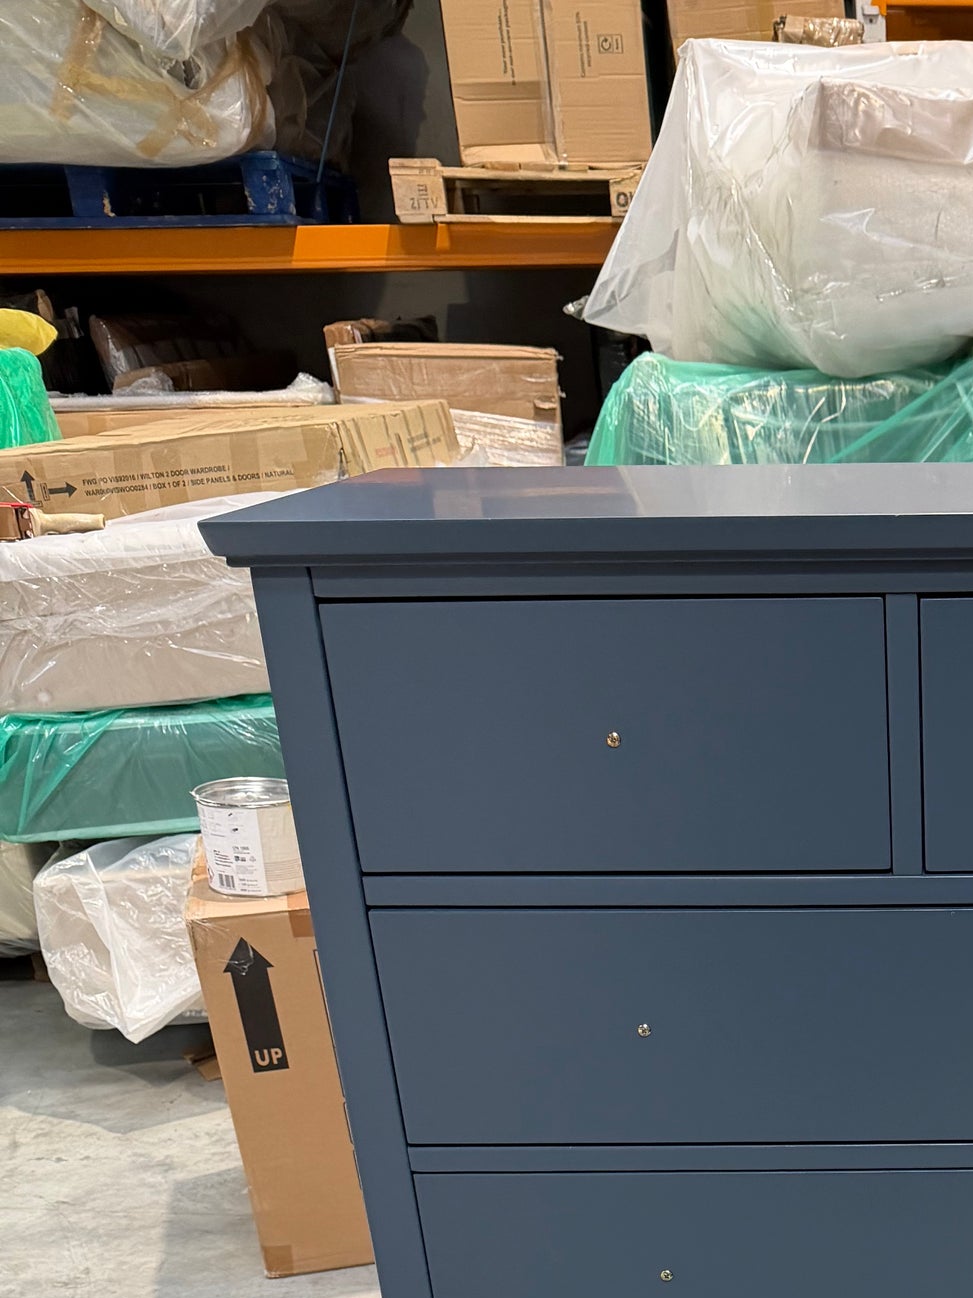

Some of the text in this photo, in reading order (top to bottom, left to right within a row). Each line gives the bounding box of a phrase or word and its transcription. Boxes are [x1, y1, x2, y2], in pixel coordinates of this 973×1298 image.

[153, 481, 167, 490] BOX
[191, 477, 205, 487] SIDE
[206, 474, 231, 485] PANELS
[238, 472, 260, 481] DOORS
[264, 469, 294, 479] NATURAL
[170, 468, 190, 477] DOOR
[190, 464, 226, 475] WARDROBE
[254, 1047, 283, 1067] UP
